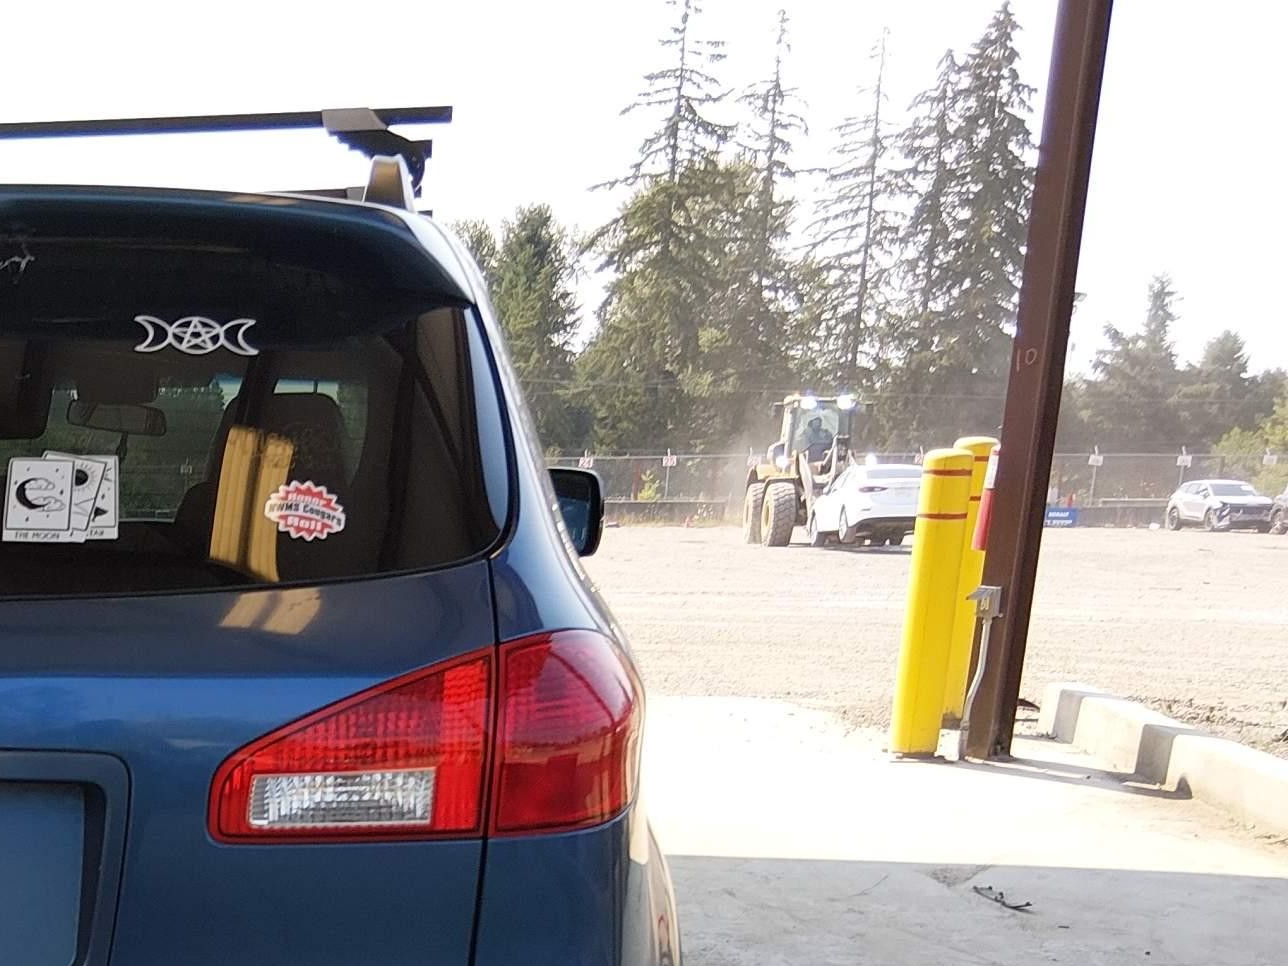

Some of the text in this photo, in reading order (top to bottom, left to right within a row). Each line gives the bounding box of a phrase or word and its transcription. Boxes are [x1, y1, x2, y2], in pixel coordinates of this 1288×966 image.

[1016, 347, 1038, 373] 10
[303, 503, 342, 528] Cougars
[15, 532, 61, 541] THE MOON
